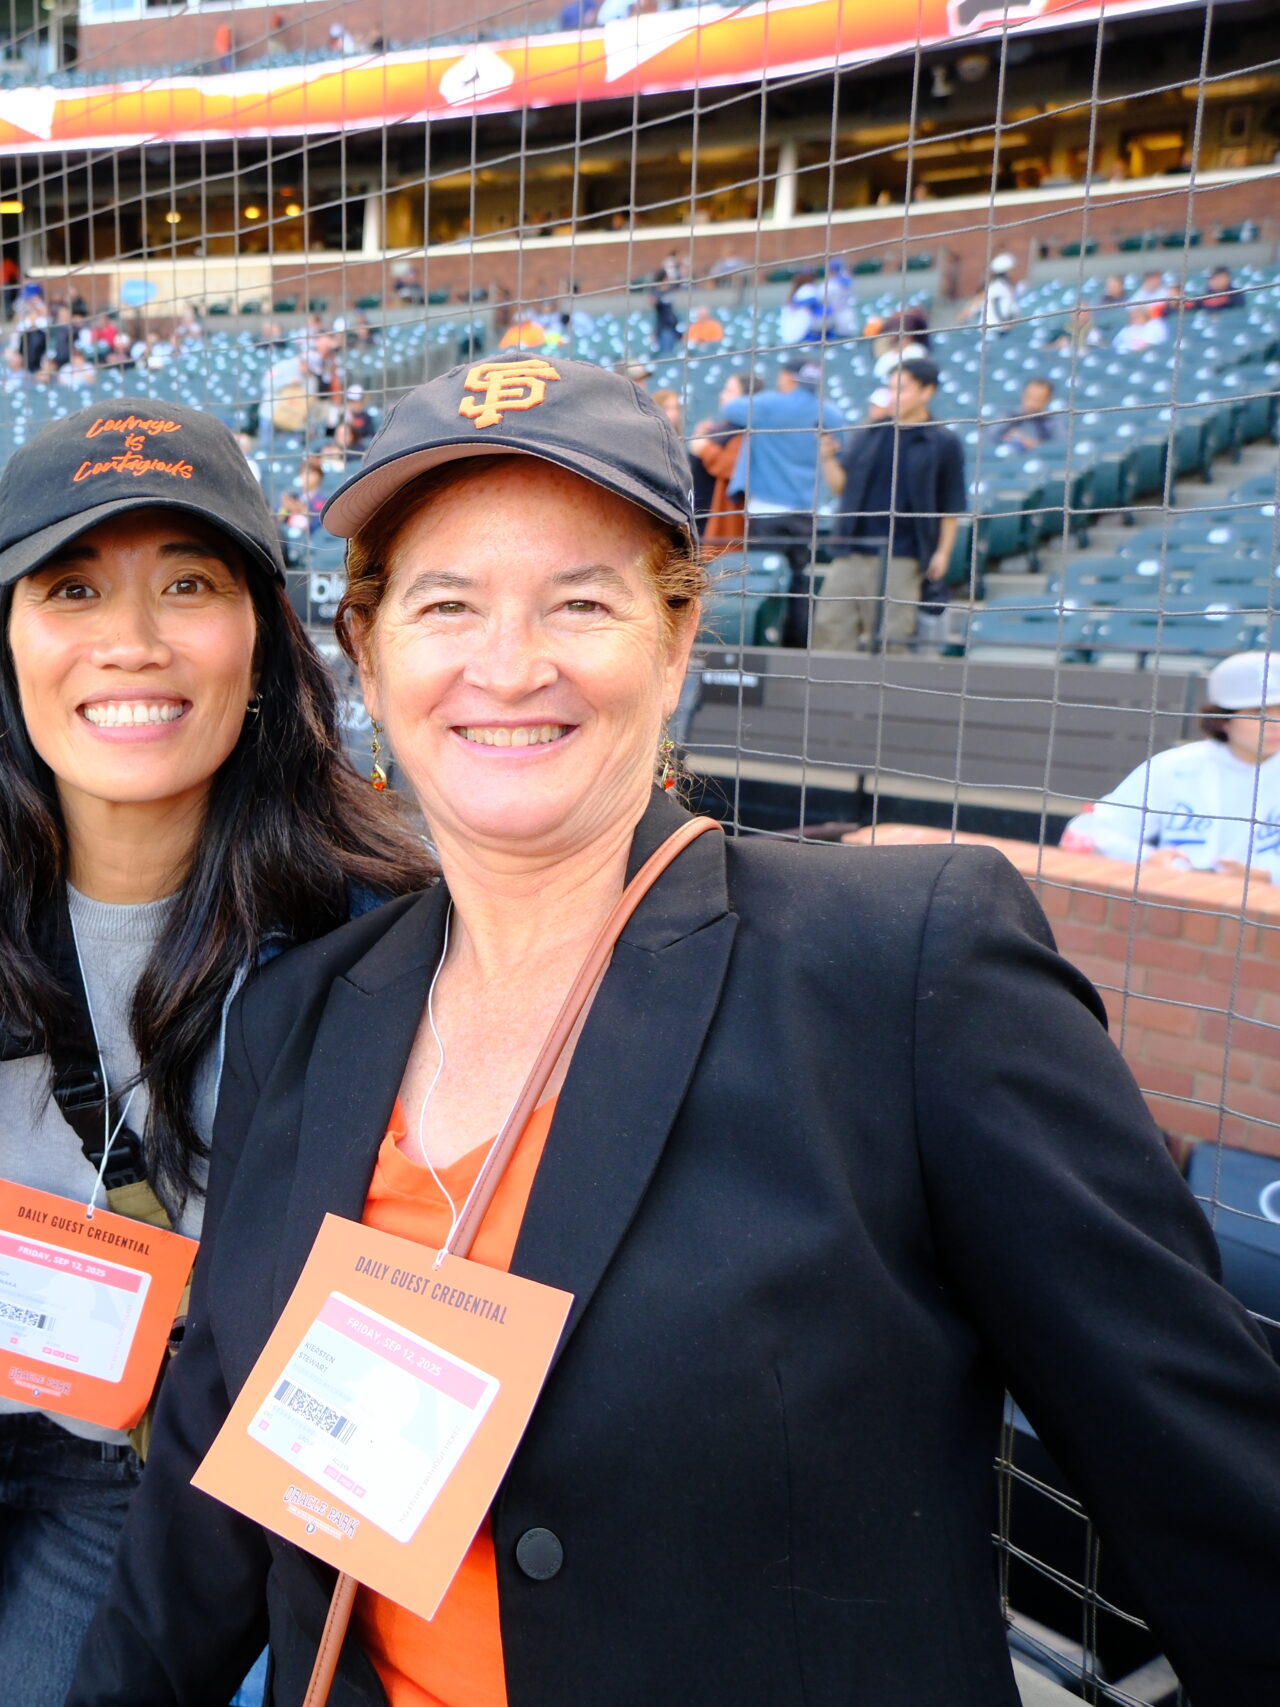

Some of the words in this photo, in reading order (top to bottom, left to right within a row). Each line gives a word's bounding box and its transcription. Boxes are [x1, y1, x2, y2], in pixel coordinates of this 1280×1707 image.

[458, 359, 561, 430] SF
[85, 415, 182, 439] Courage
[125, 432, 146, 451] is
[73, 451, 193, 482] Contagious
[18, 1206, 48, 1223] DAILY
[51, 1215, 85, 1235] GUEST
[87, 1226, 151, 1256] CREDENTIAL
[53, 1255, 70, 1266] SEP
[355, 1256, 390, 1280] DAILY
[391, 1269, 430, 1295] GUEST
[431, 1283, 508, 1325] CREDENTIAL
[298, 1351, 328, 1373] STEWART
[346, 1316, 382, 1344] FRIDAY,
[383, 1337, 402, 1353] SEP
[416, 1357, 443, 1377] 2025
[283, 1485, 327, 1516] ORACLE
[328, 1506, 359, 1539] PARK
